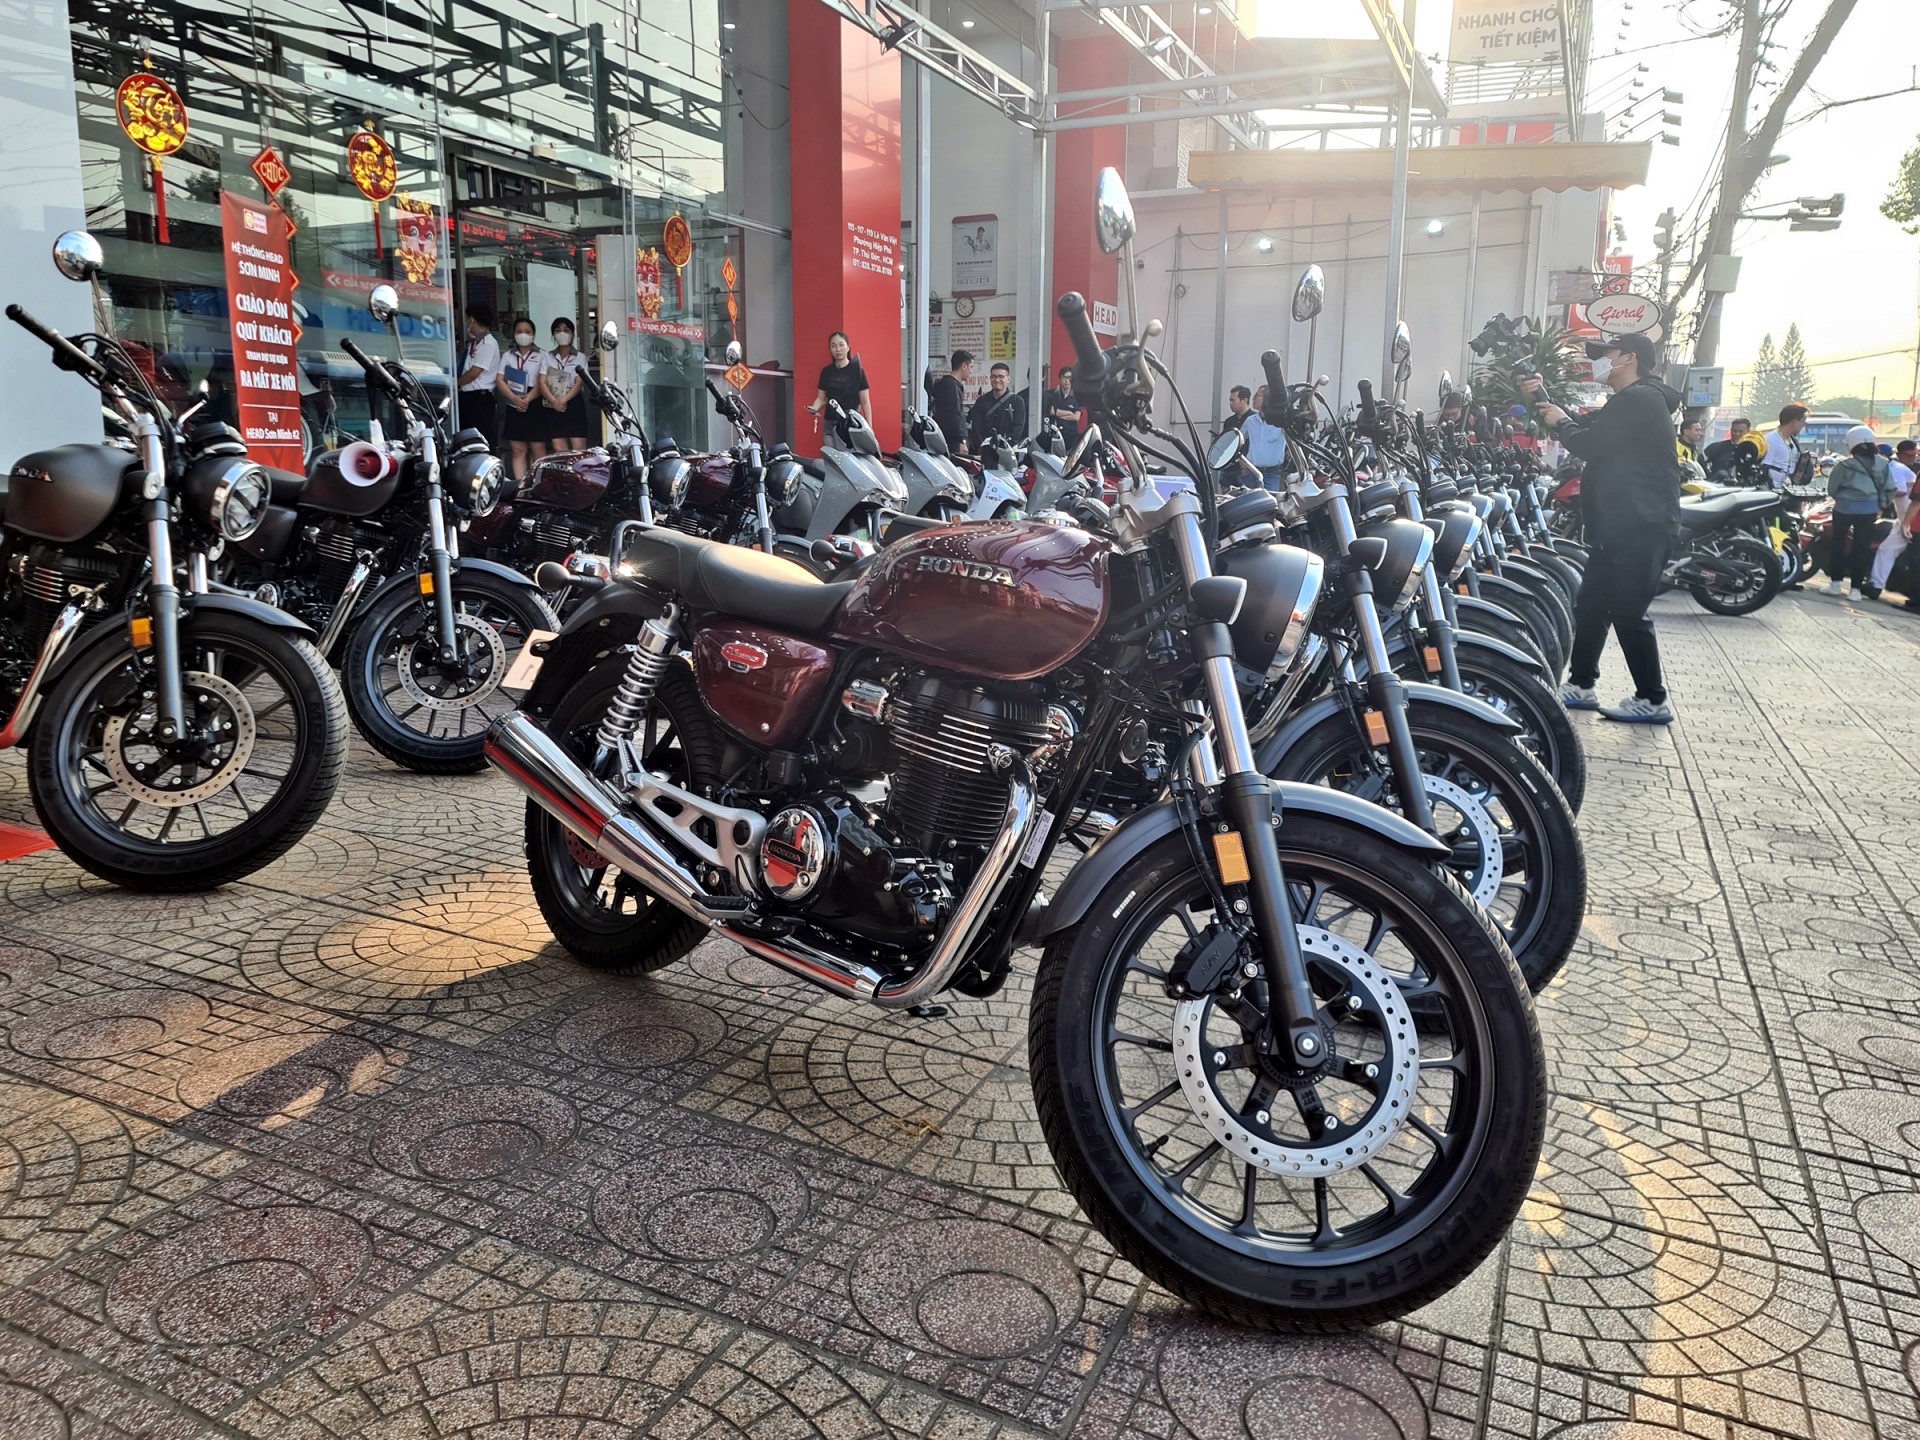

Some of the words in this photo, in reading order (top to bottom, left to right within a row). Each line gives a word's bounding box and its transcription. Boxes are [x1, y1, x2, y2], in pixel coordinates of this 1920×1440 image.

[1457, 11, 1516, 30] NHANH
[1480, 28, 1513, 49] TIẾT
[1516, 26, 1557, 48] KIỆM
[231, 240, 242, 256] HỆ
[242, 244, 266, 259] THỐNG
[265, 250, 284, 265] HEAD
[853, 235, 873, 250] Phường
[872, 241, 883, 253] Hiệp
[883, 244, 893, 255] Phú
[239, 259, 257, 278] SƠN
[258, 266, 281, 283] MINH
[882, 254, 894, 266] HCM
[235, 291, 266, 315] CHÀO
[265, 297, 289, 320] ĐÓN
[1094, 305, 1116, 327] HEAD
[1596, 305, 1645, 326] Givral
[236, 319, 258, 342] QUÝ
[259, 324, 293, 346] KHÁCH
[245, 350, 261, 361] THAM
[260, 351, 269, 364] DỰ
[268, 352, 277, 364] SỰ
[276, 353, 289, 365] KIỆN
[239, 369, 253, 387] RA
[252, 366, 270, 389] MẮT
[270, 373, 281, 390] XE
[280, 371, 297, 392] MỚI
[267, 411, 279, 425] TẠI
[245, 427, 265, 439] HEAD
[264, 427, 277, 440] Sơn
[276, 427, 293, 440] Minh
[292, 429, 300, 440] #2
[917, 555, 1019, 588] HONDA
[770, 844, 801, 863] HONDA
[1290, 1165, 1507, 1300] ZAPPER-FS
